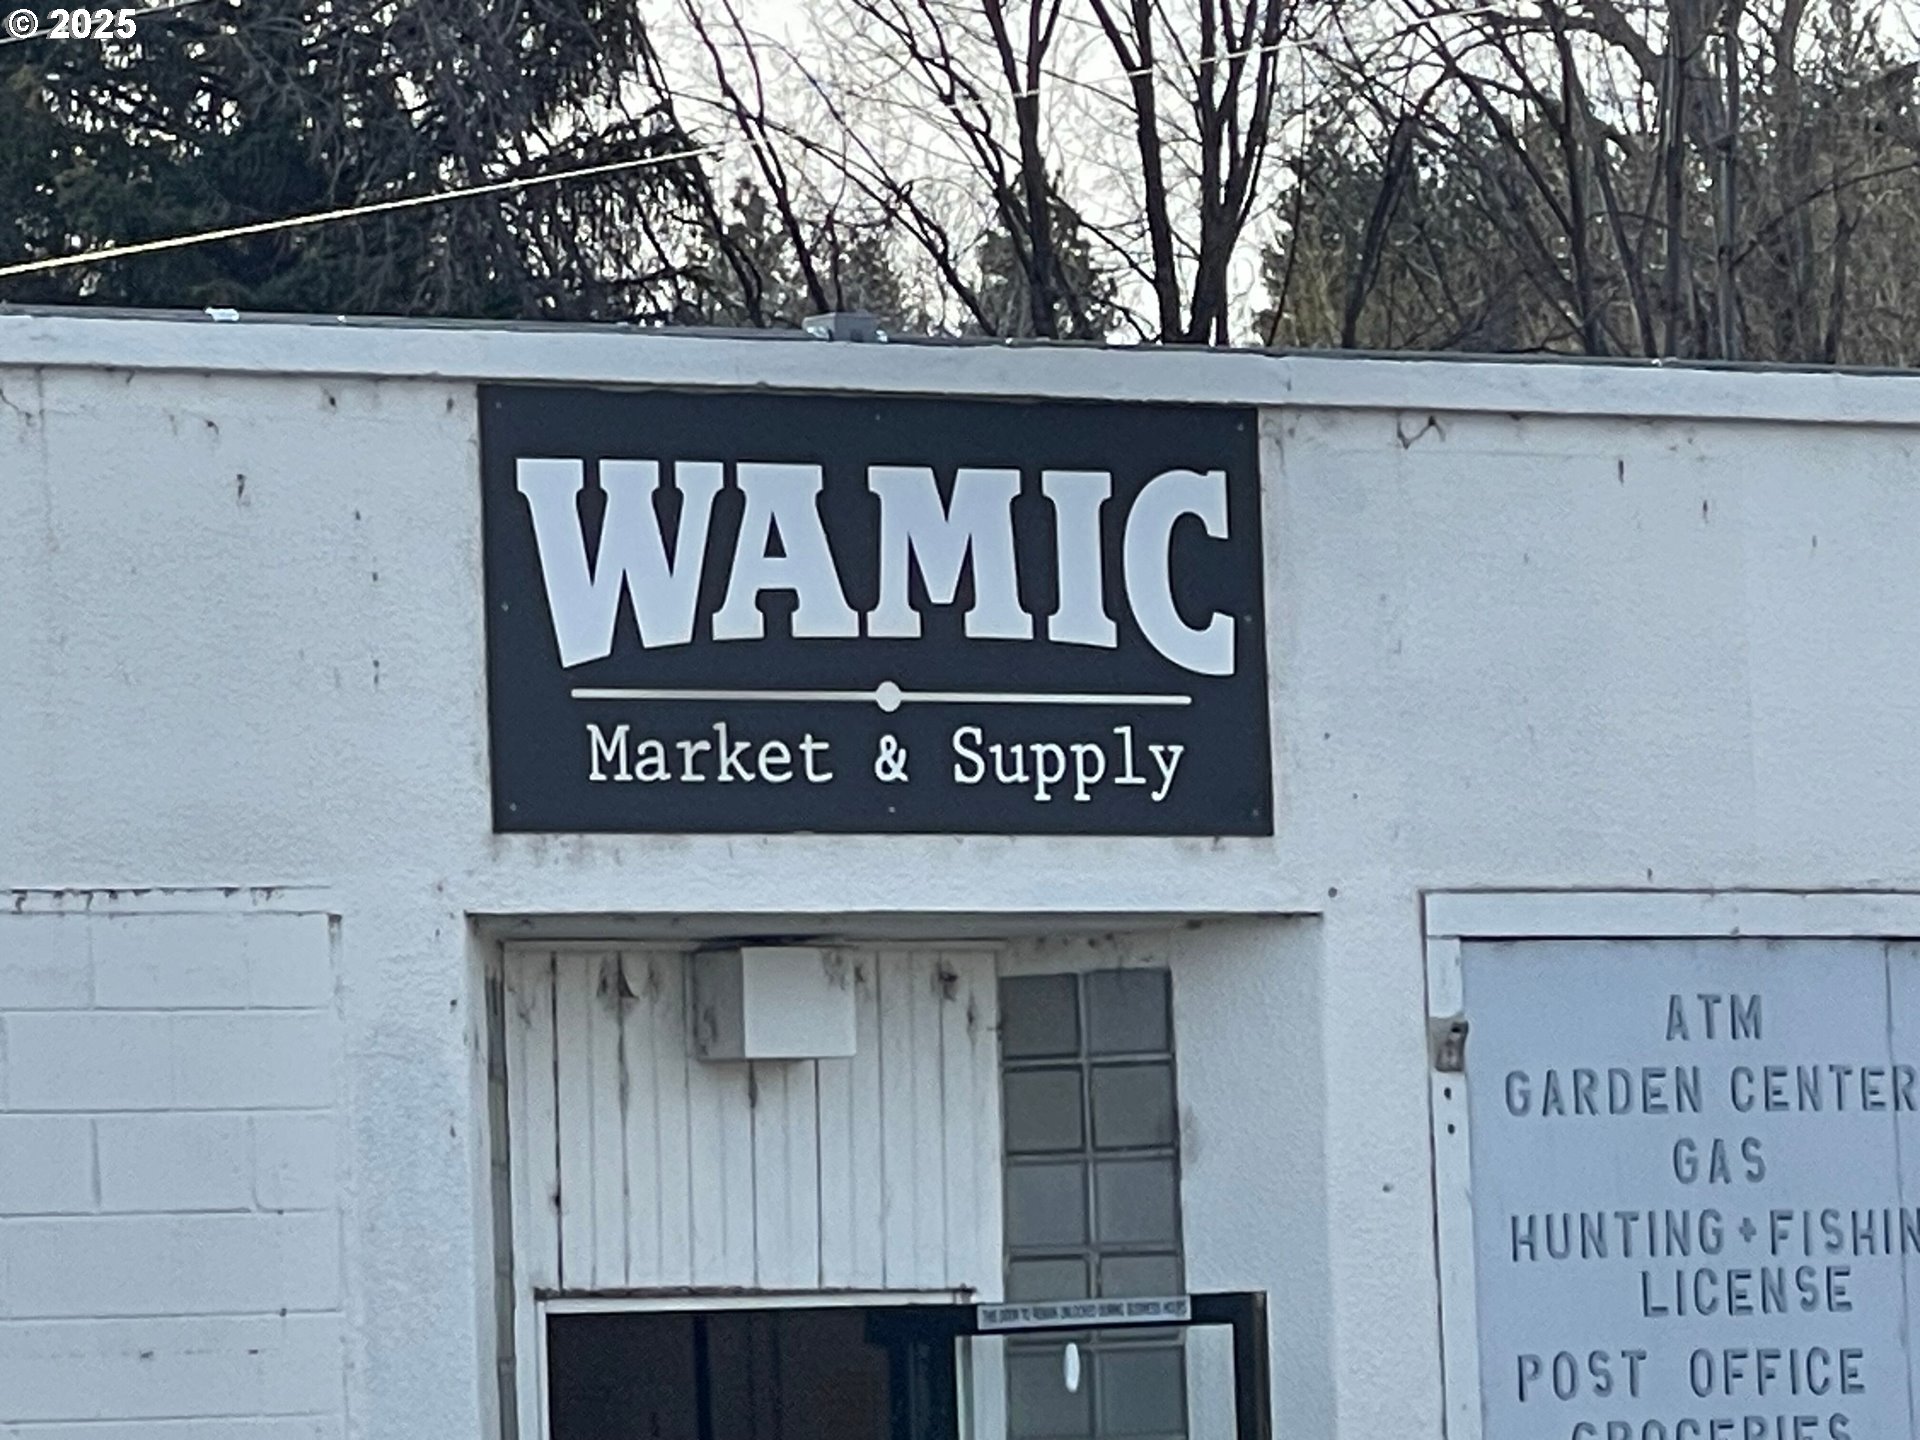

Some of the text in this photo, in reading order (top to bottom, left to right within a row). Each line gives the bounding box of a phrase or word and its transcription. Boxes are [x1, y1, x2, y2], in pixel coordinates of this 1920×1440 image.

[516, 457, 1236, 676] WAMIC
[587, 722, 1186, 803] Market & Supply
[1665, 994, 1764, 1041] ATM
[1504, 1064, 1919, 1117] GARDEN CENTER
[1672, 1136, 1767, 1185] GAS
[1641, 1265, 1854, 1317] LICENSE
[1516, 1346, 1866, 1402] POST OFFICE
